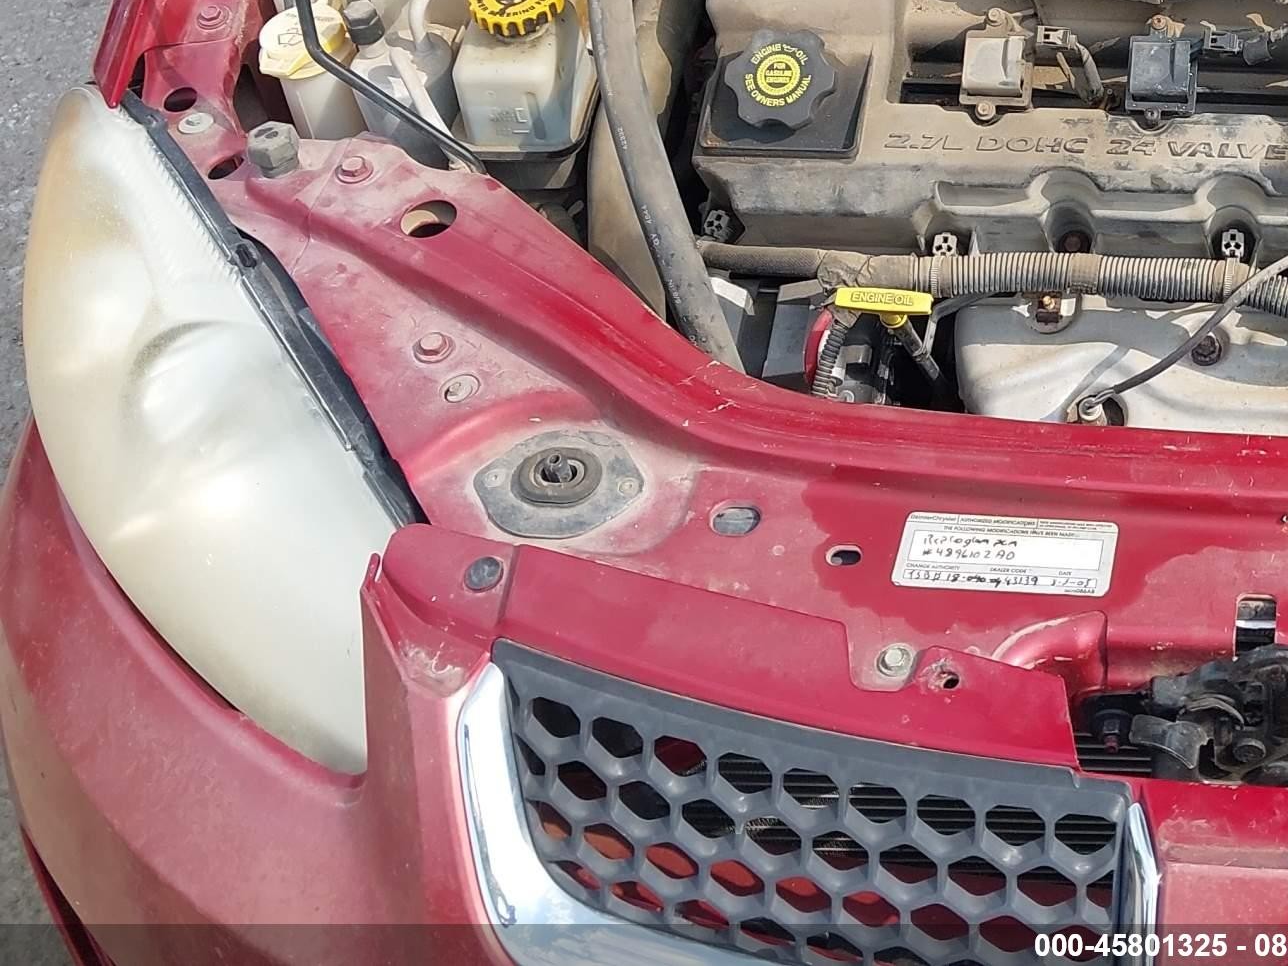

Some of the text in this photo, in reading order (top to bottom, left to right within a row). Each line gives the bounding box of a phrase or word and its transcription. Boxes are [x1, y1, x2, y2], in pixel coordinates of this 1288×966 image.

[750, 43, 809, 65] ENGINE OIL
[745, 73, 812, 107] SEE OWNERS MANUAL
[884, 133, 963, 151] 2.7L
[975, 135, 1090, 153] DOHC
[1106, 138, 1157, 156] 24
[851, 291, 913, 306] ENGINE OIL
